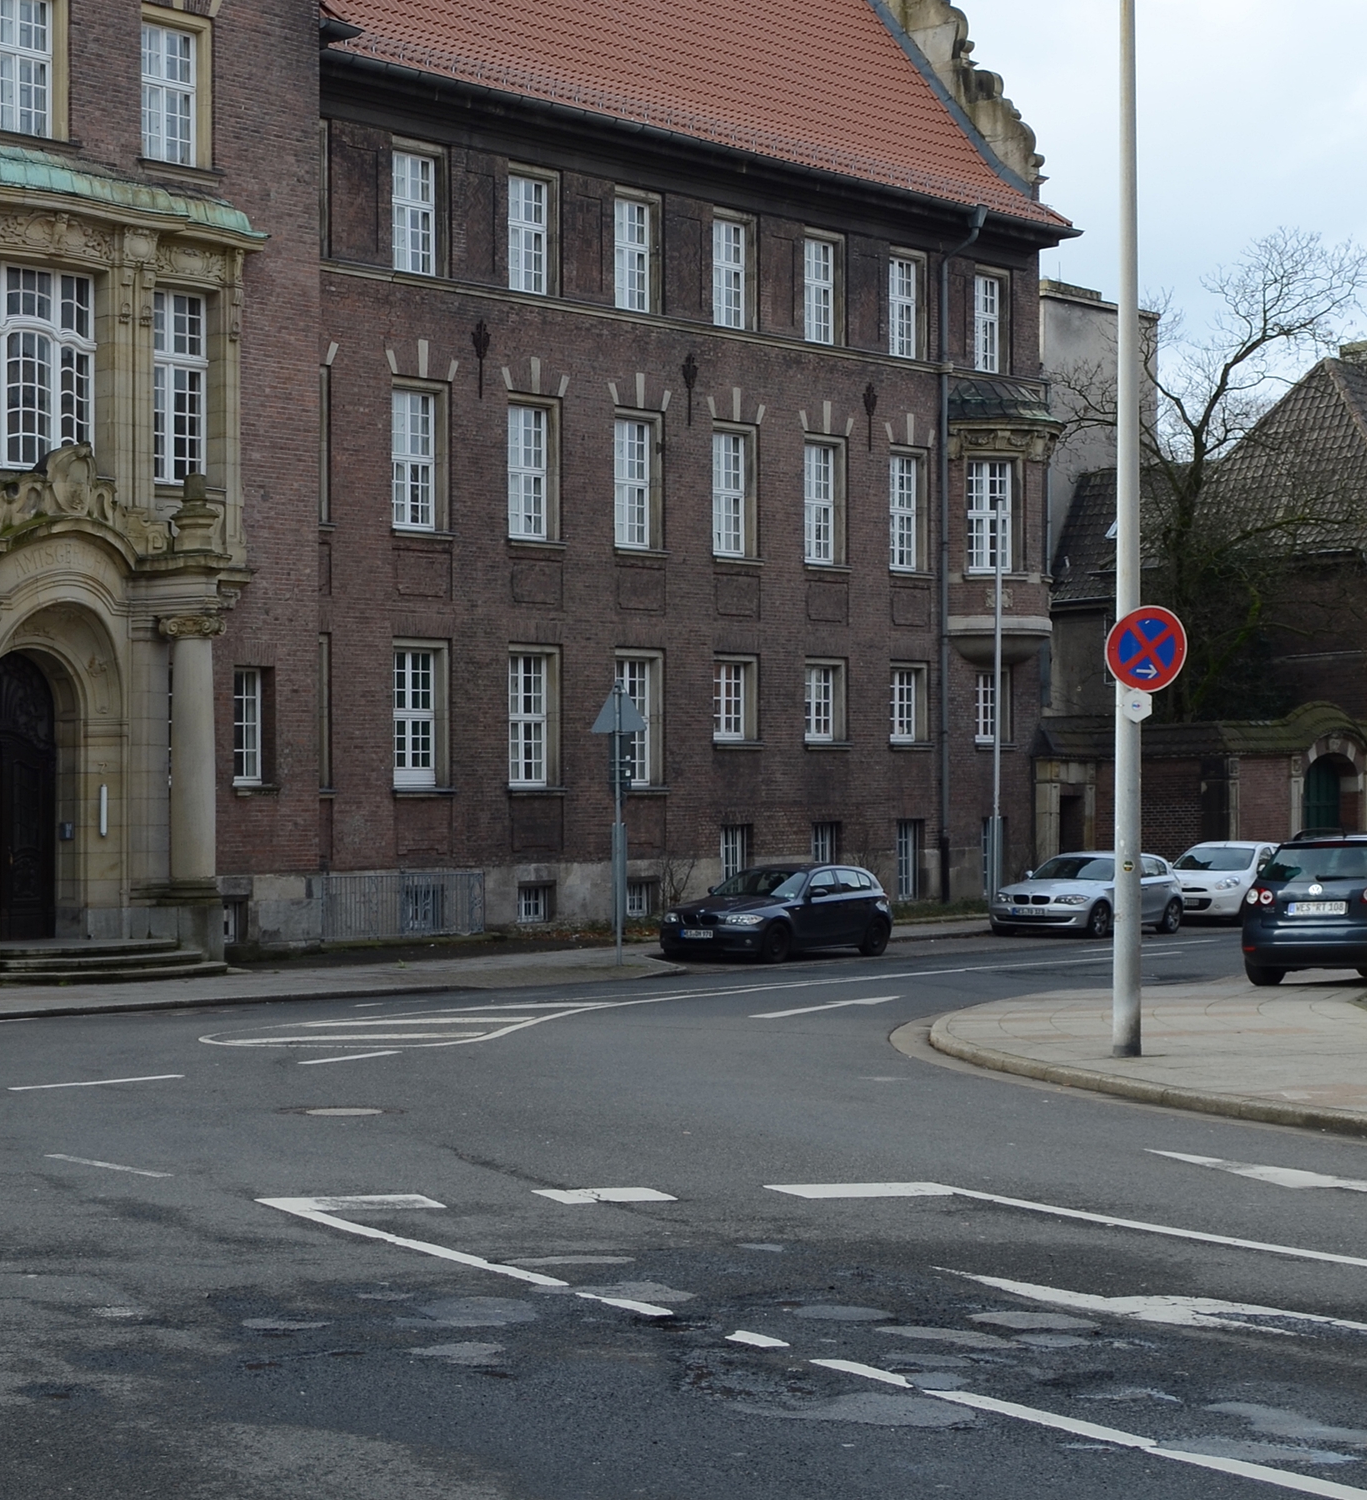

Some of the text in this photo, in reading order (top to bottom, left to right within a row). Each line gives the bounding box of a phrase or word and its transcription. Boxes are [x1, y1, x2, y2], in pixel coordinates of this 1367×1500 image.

[14, 543, 108, 579] AMTSGERICHT
[1296, 902, 1344, 912] WES RT 108
